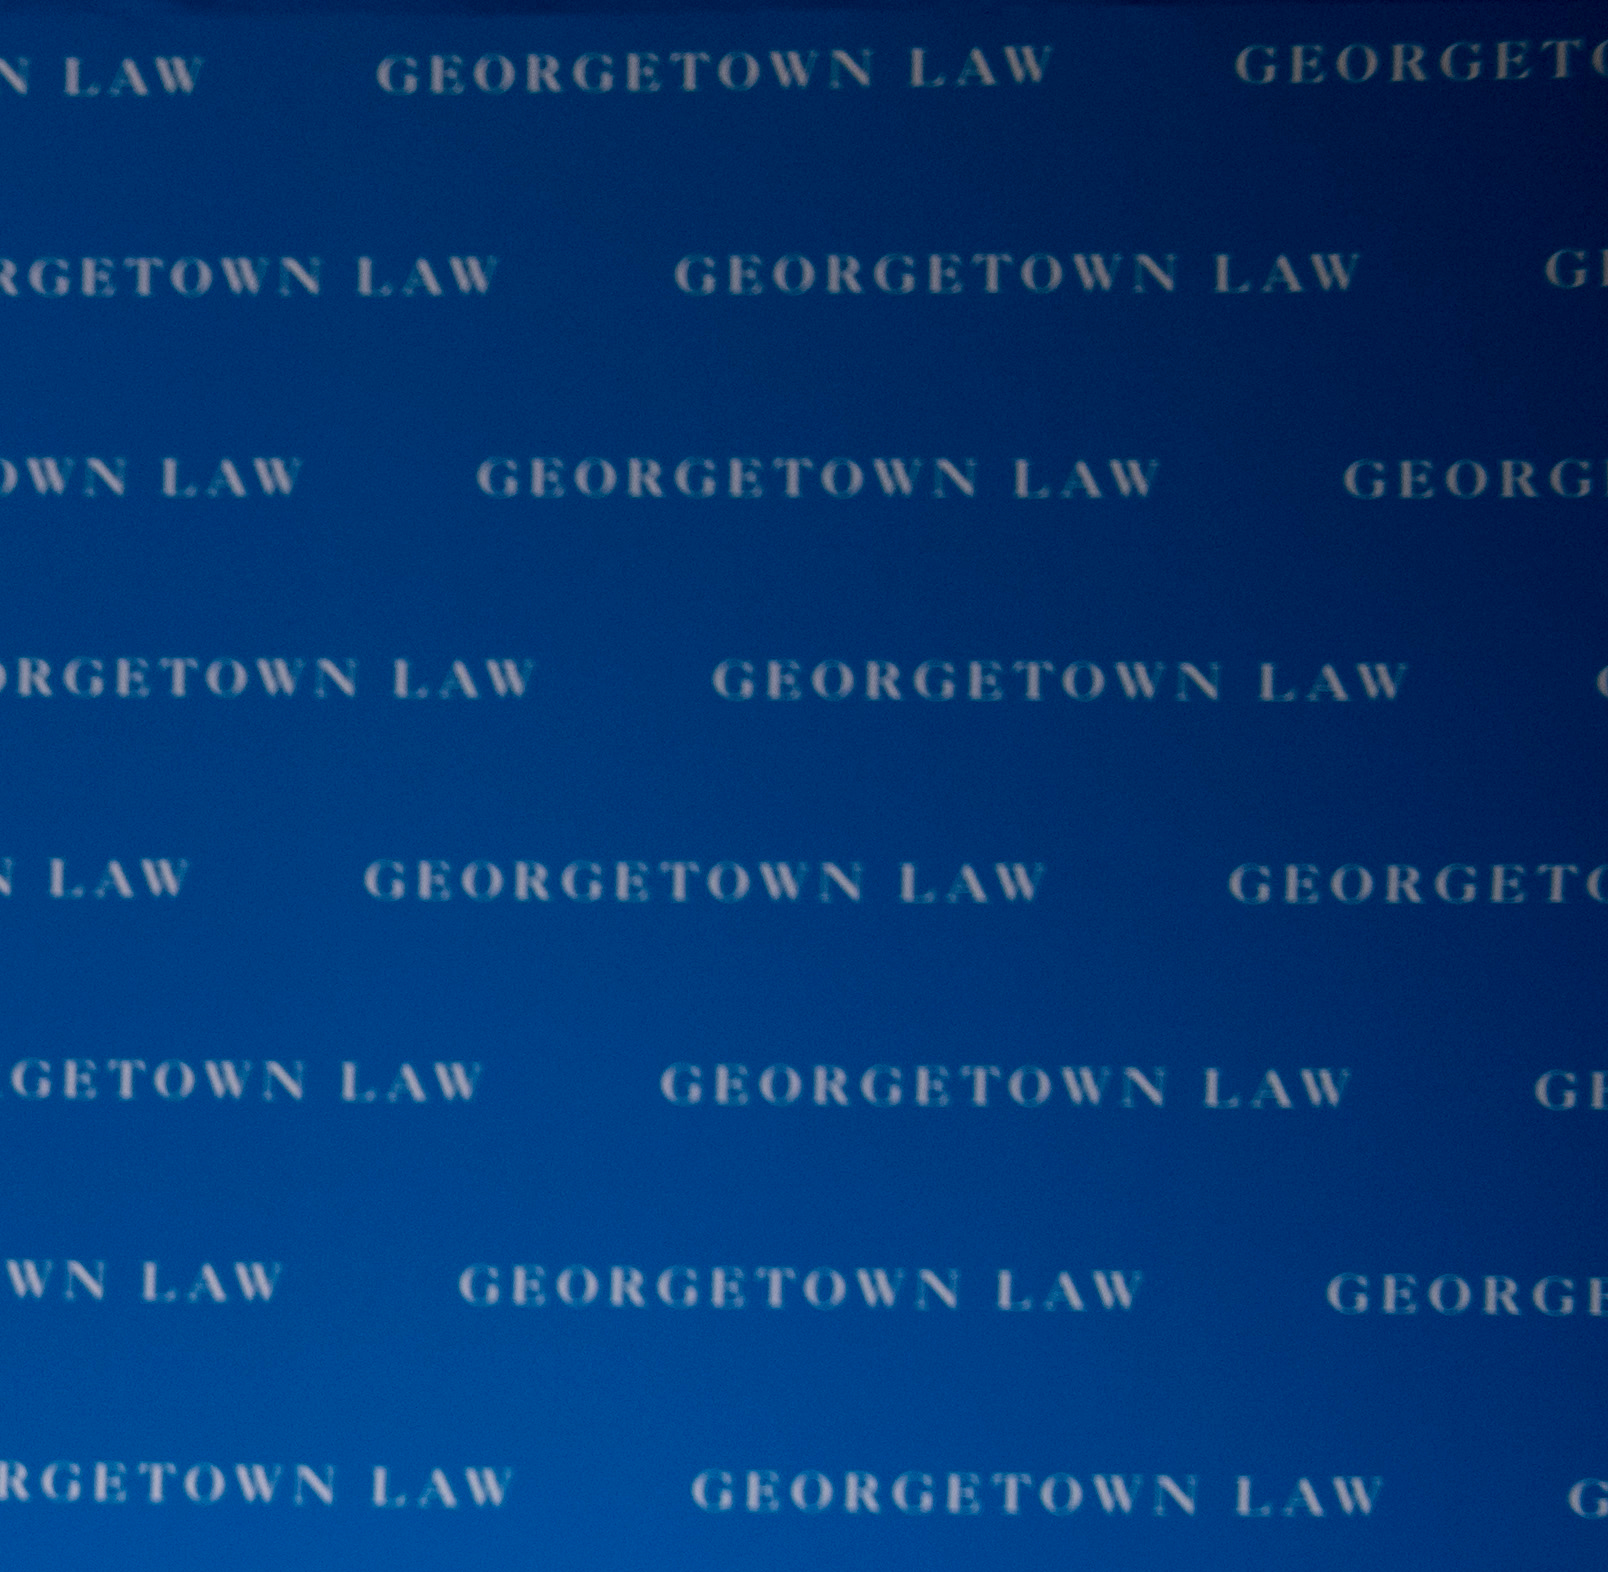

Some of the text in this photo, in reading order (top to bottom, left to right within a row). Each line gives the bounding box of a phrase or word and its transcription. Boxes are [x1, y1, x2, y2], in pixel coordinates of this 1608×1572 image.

[65, 56, 202, 96] LAW
[376, 45, 1051, 94] GEORGETOWN LAW
[358, 256, 497, 296] LAW
[674, 253, 1358, 295] GEORGETOWN LAW
[162, 457, 301, 497] LAW
[476, 457, 1157, 498] GEORGETOWN LAW
[1343, 460, 1608, 499] GEORG
[394, 658, 533, 699] LAW
[712, 660, 1405, 702] GEORGETOWN LAW
[50, 858, 194, 898] LAW
[364, 860, 1043, 903] GEORGETOWN LAW
[342, 1061, 481, 1102] LAW
[660, 1064, 1348, 1108] GEORGETOWN LAW
[142, 1261, 281, 1303] LAW
[458, 1265, 1140, 1311] GEORGETOWN LAW
[372, 1466, 512, 1508] LAW
[691, 1471, 1380, 1517] GEORGETOWN LAW
